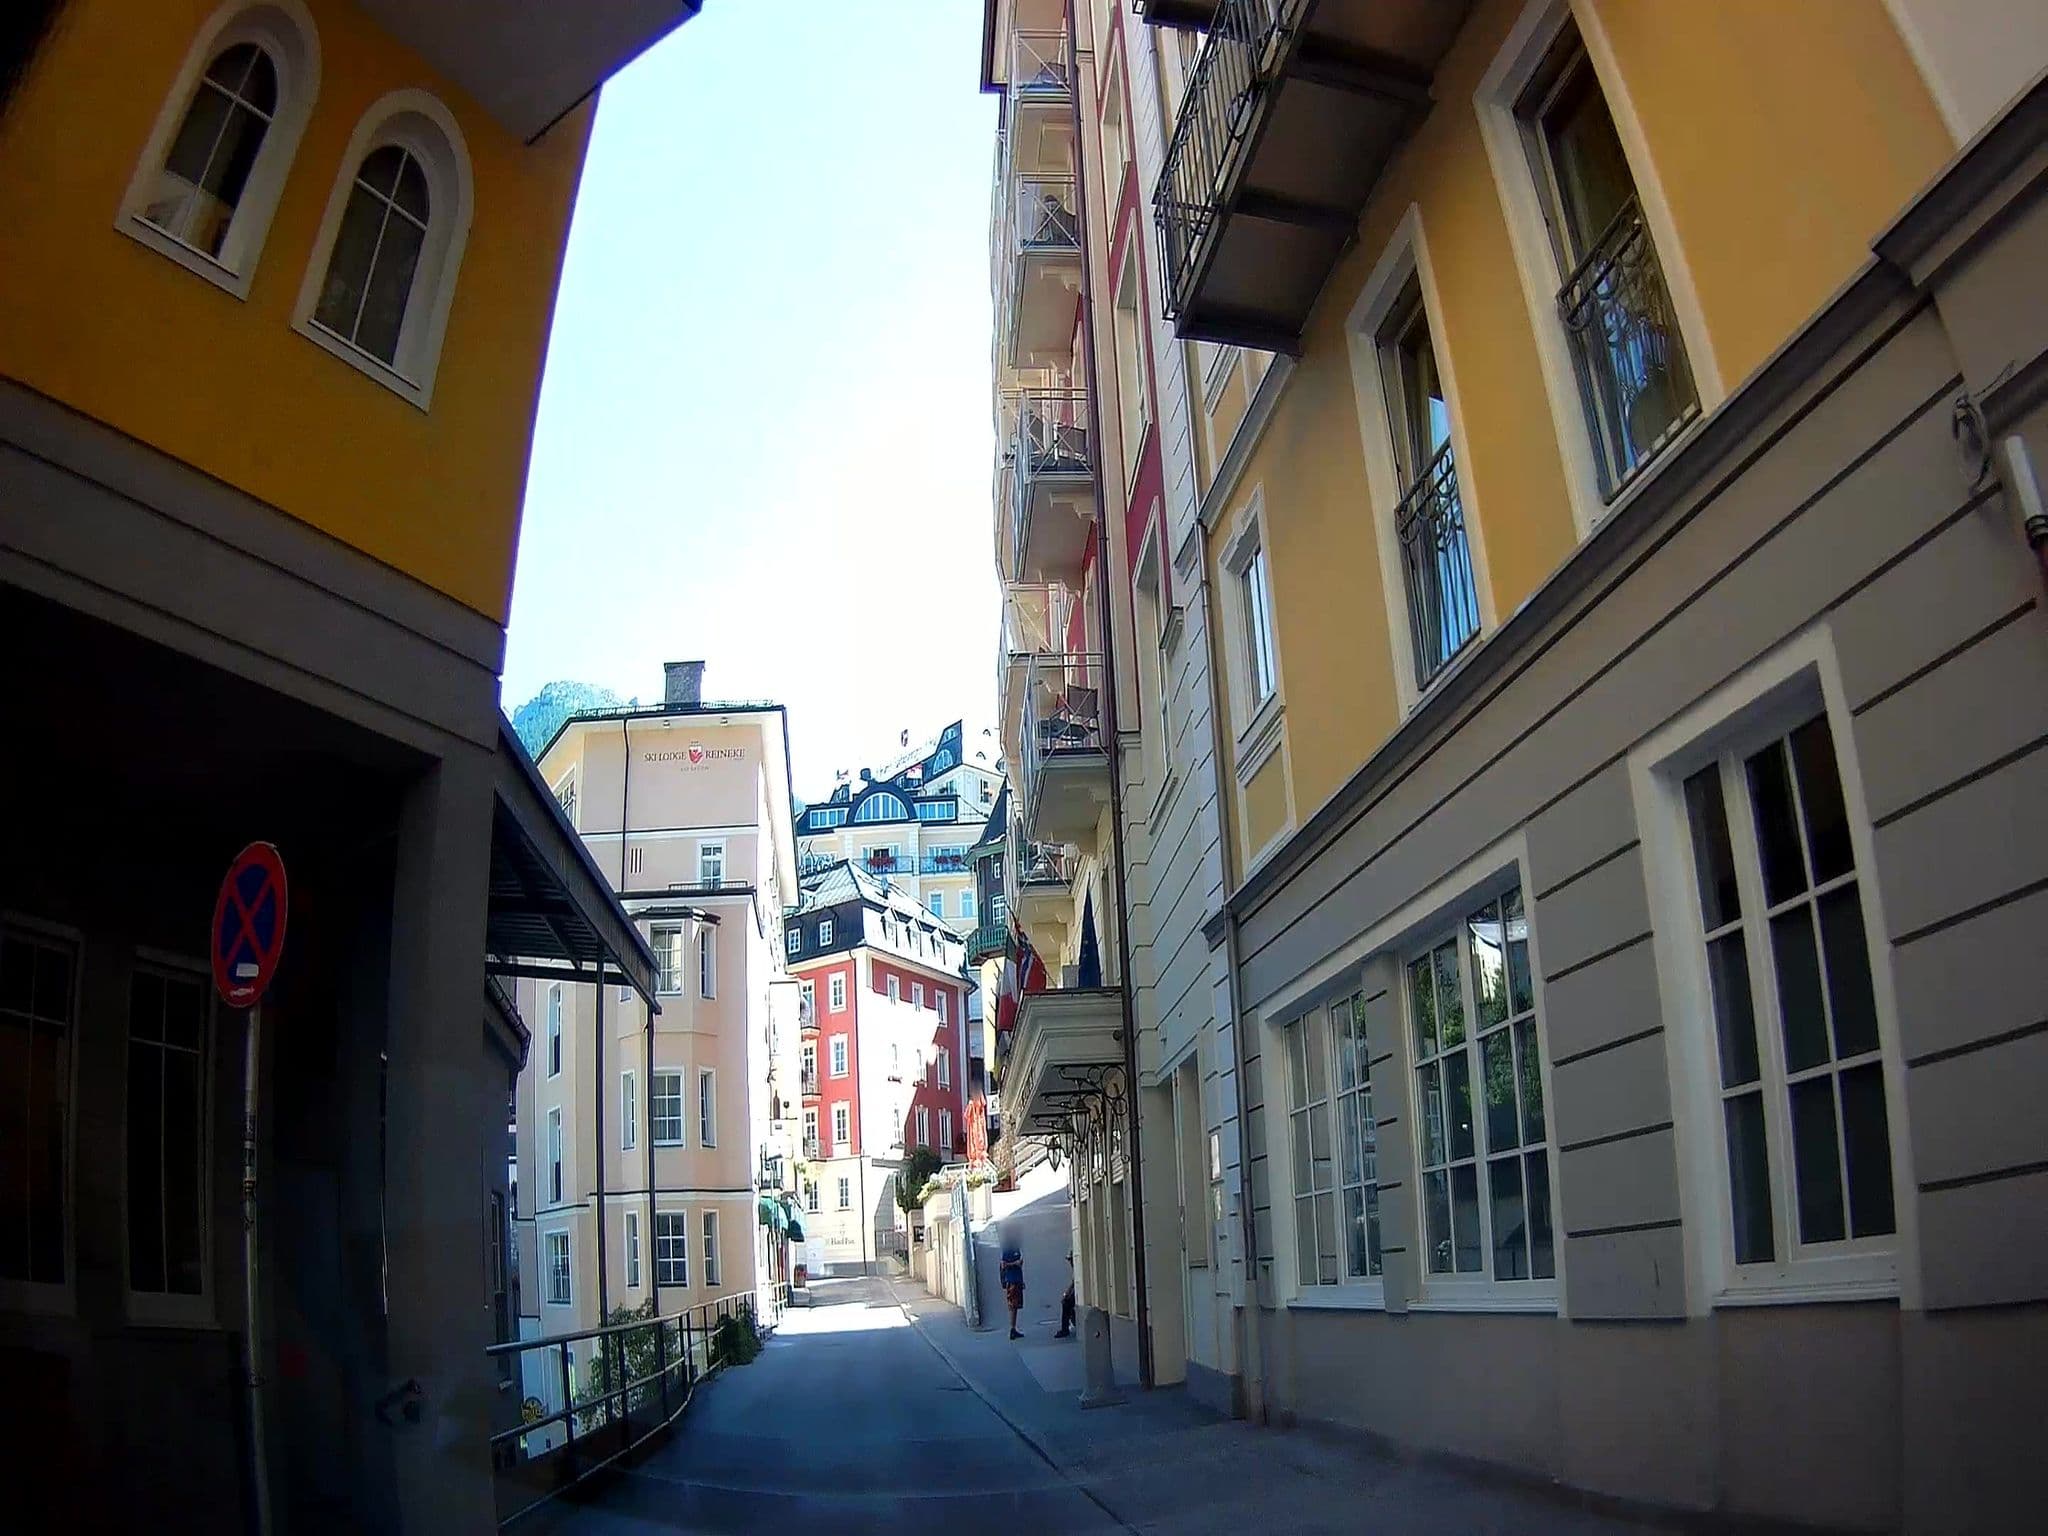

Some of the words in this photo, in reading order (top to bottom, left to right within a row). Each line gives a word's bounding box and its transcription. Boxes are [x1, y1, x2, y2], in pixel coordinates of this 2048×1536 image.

[644, 752, 657, 761] SKI
[658, 751, 687, 761] LODGE
[705, 749, 744, 759] REINEKE
